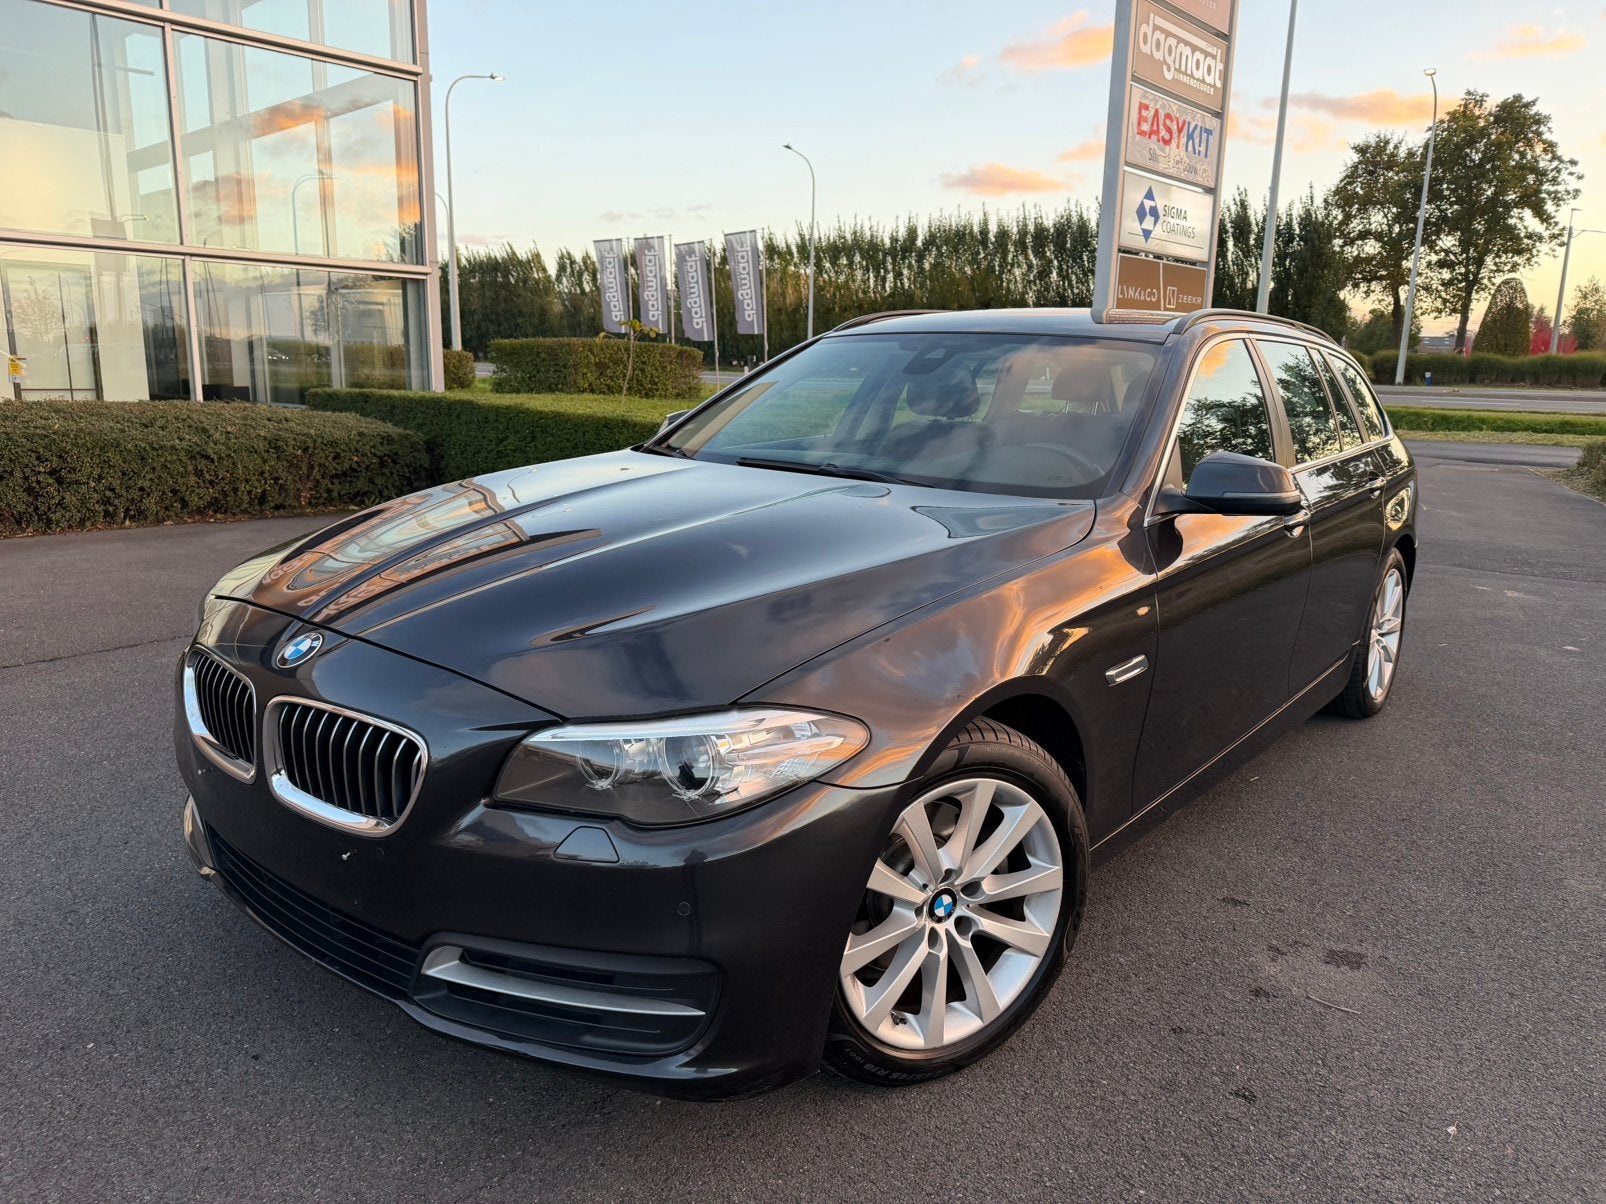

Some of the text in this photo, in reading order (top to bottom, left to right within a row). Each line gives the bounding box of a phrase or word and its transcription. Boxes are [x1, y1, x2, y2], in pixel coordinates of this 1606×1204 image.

[1139, 12, 1224, 88] dagmaat
[1162, 204, 1188, 222] SIGMA
[1161, 220, 1196, 239] COATINGS
[1178, 294, 1202, 305] ZEEKR
